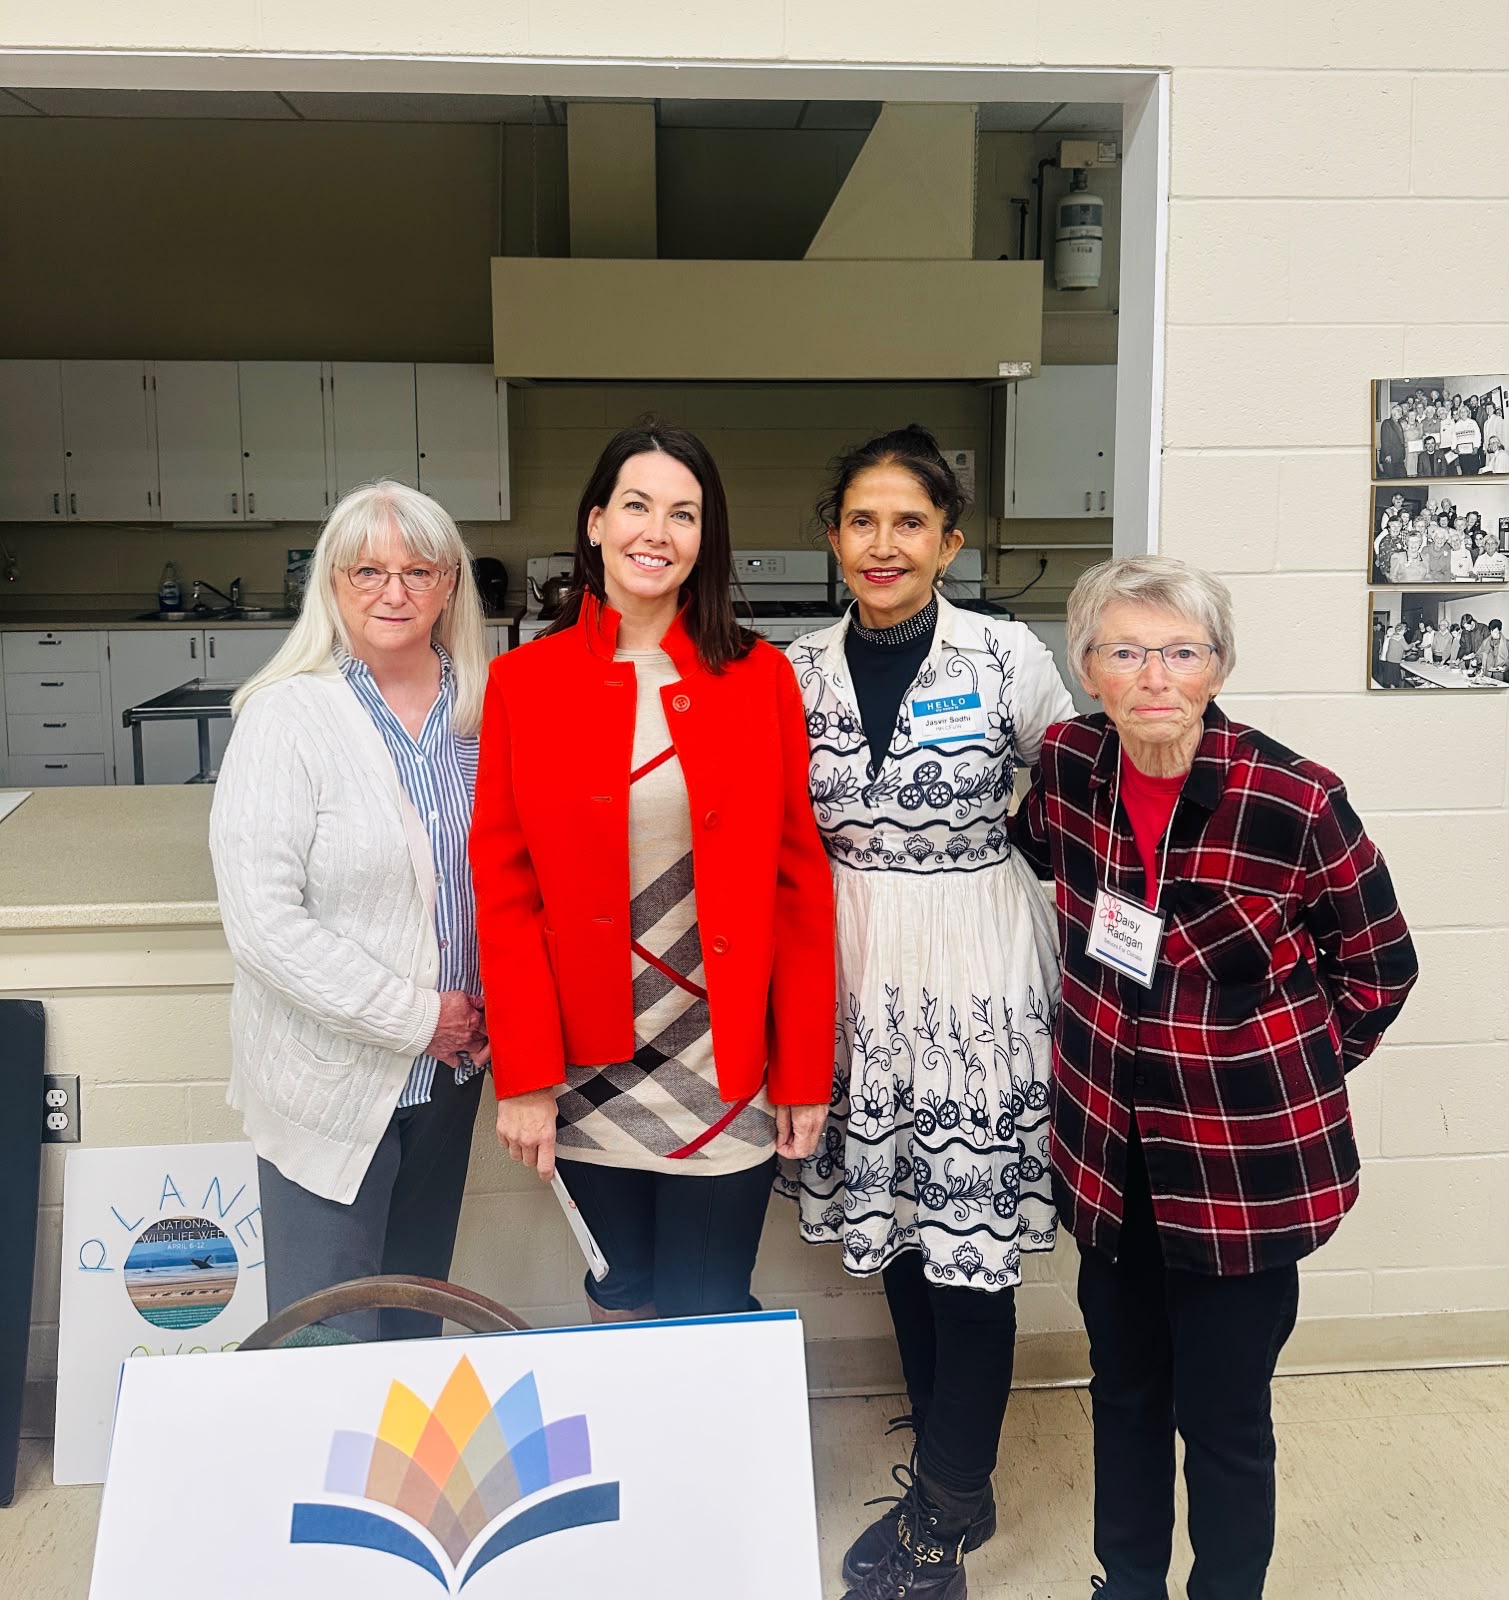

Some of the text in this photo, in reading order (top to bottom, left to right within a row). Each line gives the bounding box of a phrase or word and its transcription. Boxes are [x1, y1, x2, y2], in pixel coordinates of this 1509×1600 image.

[927, 698, 966, 711] HELLO
[926, 716, 971, 727] Jasvir Sodhi
[1115, 911, 1141, 933] Daisy
[1107, 925, 1143, 950] Radigan
[157, 1219, 216, 1231] NATIONAL
[141, 1230, 228, 1244] WILDLIFE WEE
